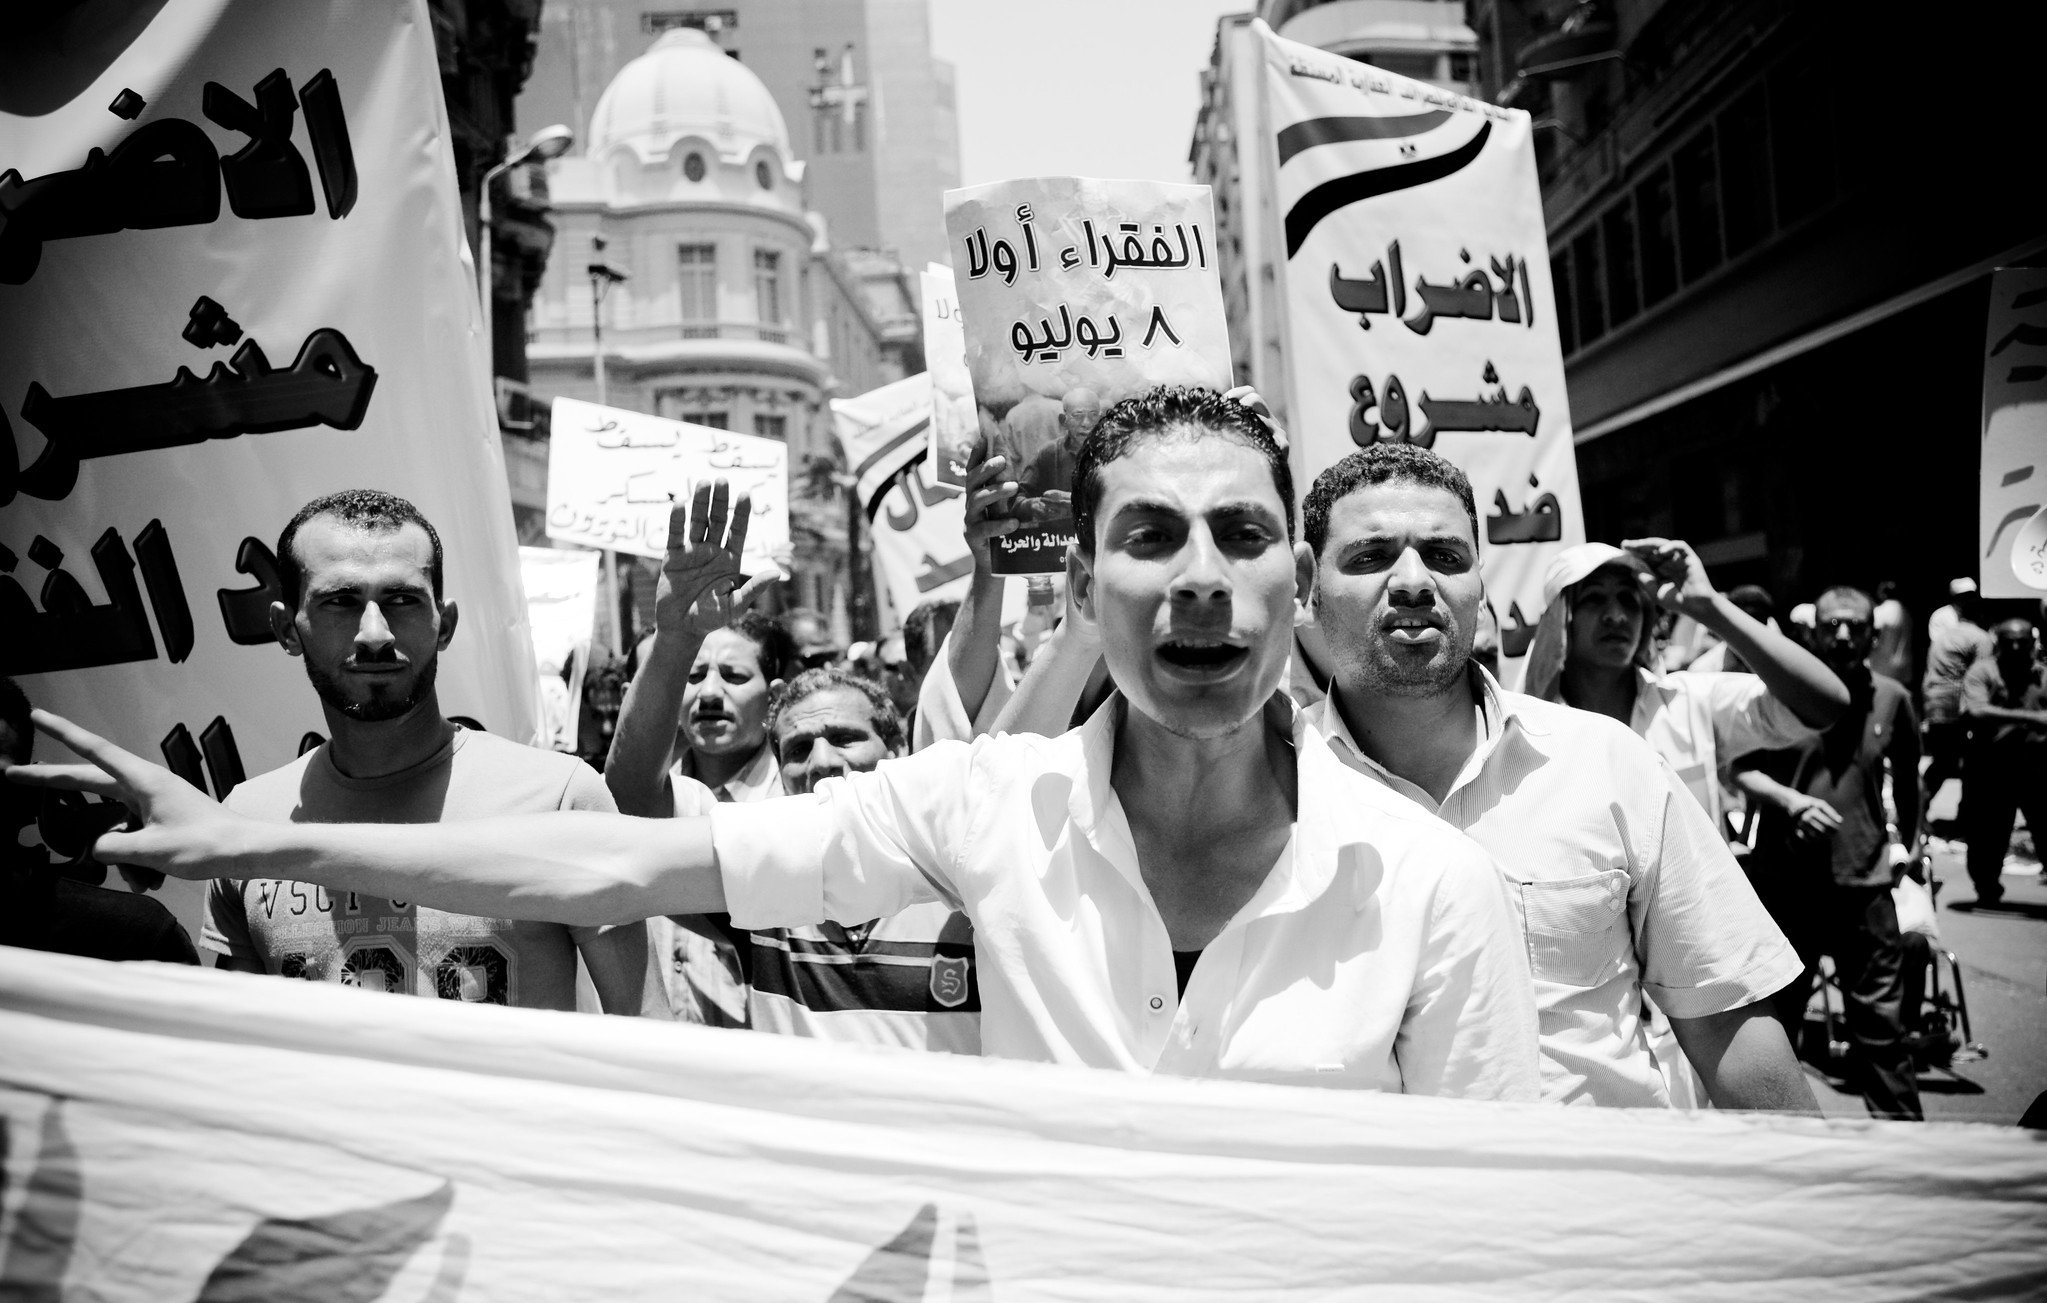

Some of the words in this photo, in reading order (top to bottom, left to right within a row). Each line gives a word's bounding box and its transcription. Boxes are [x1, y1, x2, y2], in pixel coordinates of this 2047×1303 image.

[964, 203, 1040, 287] أولا
[1059, 219, 1207, 280] الفقراء
[1329, 238, 1534, 337] الاضراب
[1011, 302, 1126, 364] يوليو
[1141, 304, 1184, 349] ٨
[0, 295, 378, 501] مشر
[1349, 359, 1541, 449] مشروع
[585, 415, 681, 459] يسقط
[1486, 472, 1562, 545] ضد
[1000, 534, 1041, 554] والحرية
[941, 968, 961, 995] S
